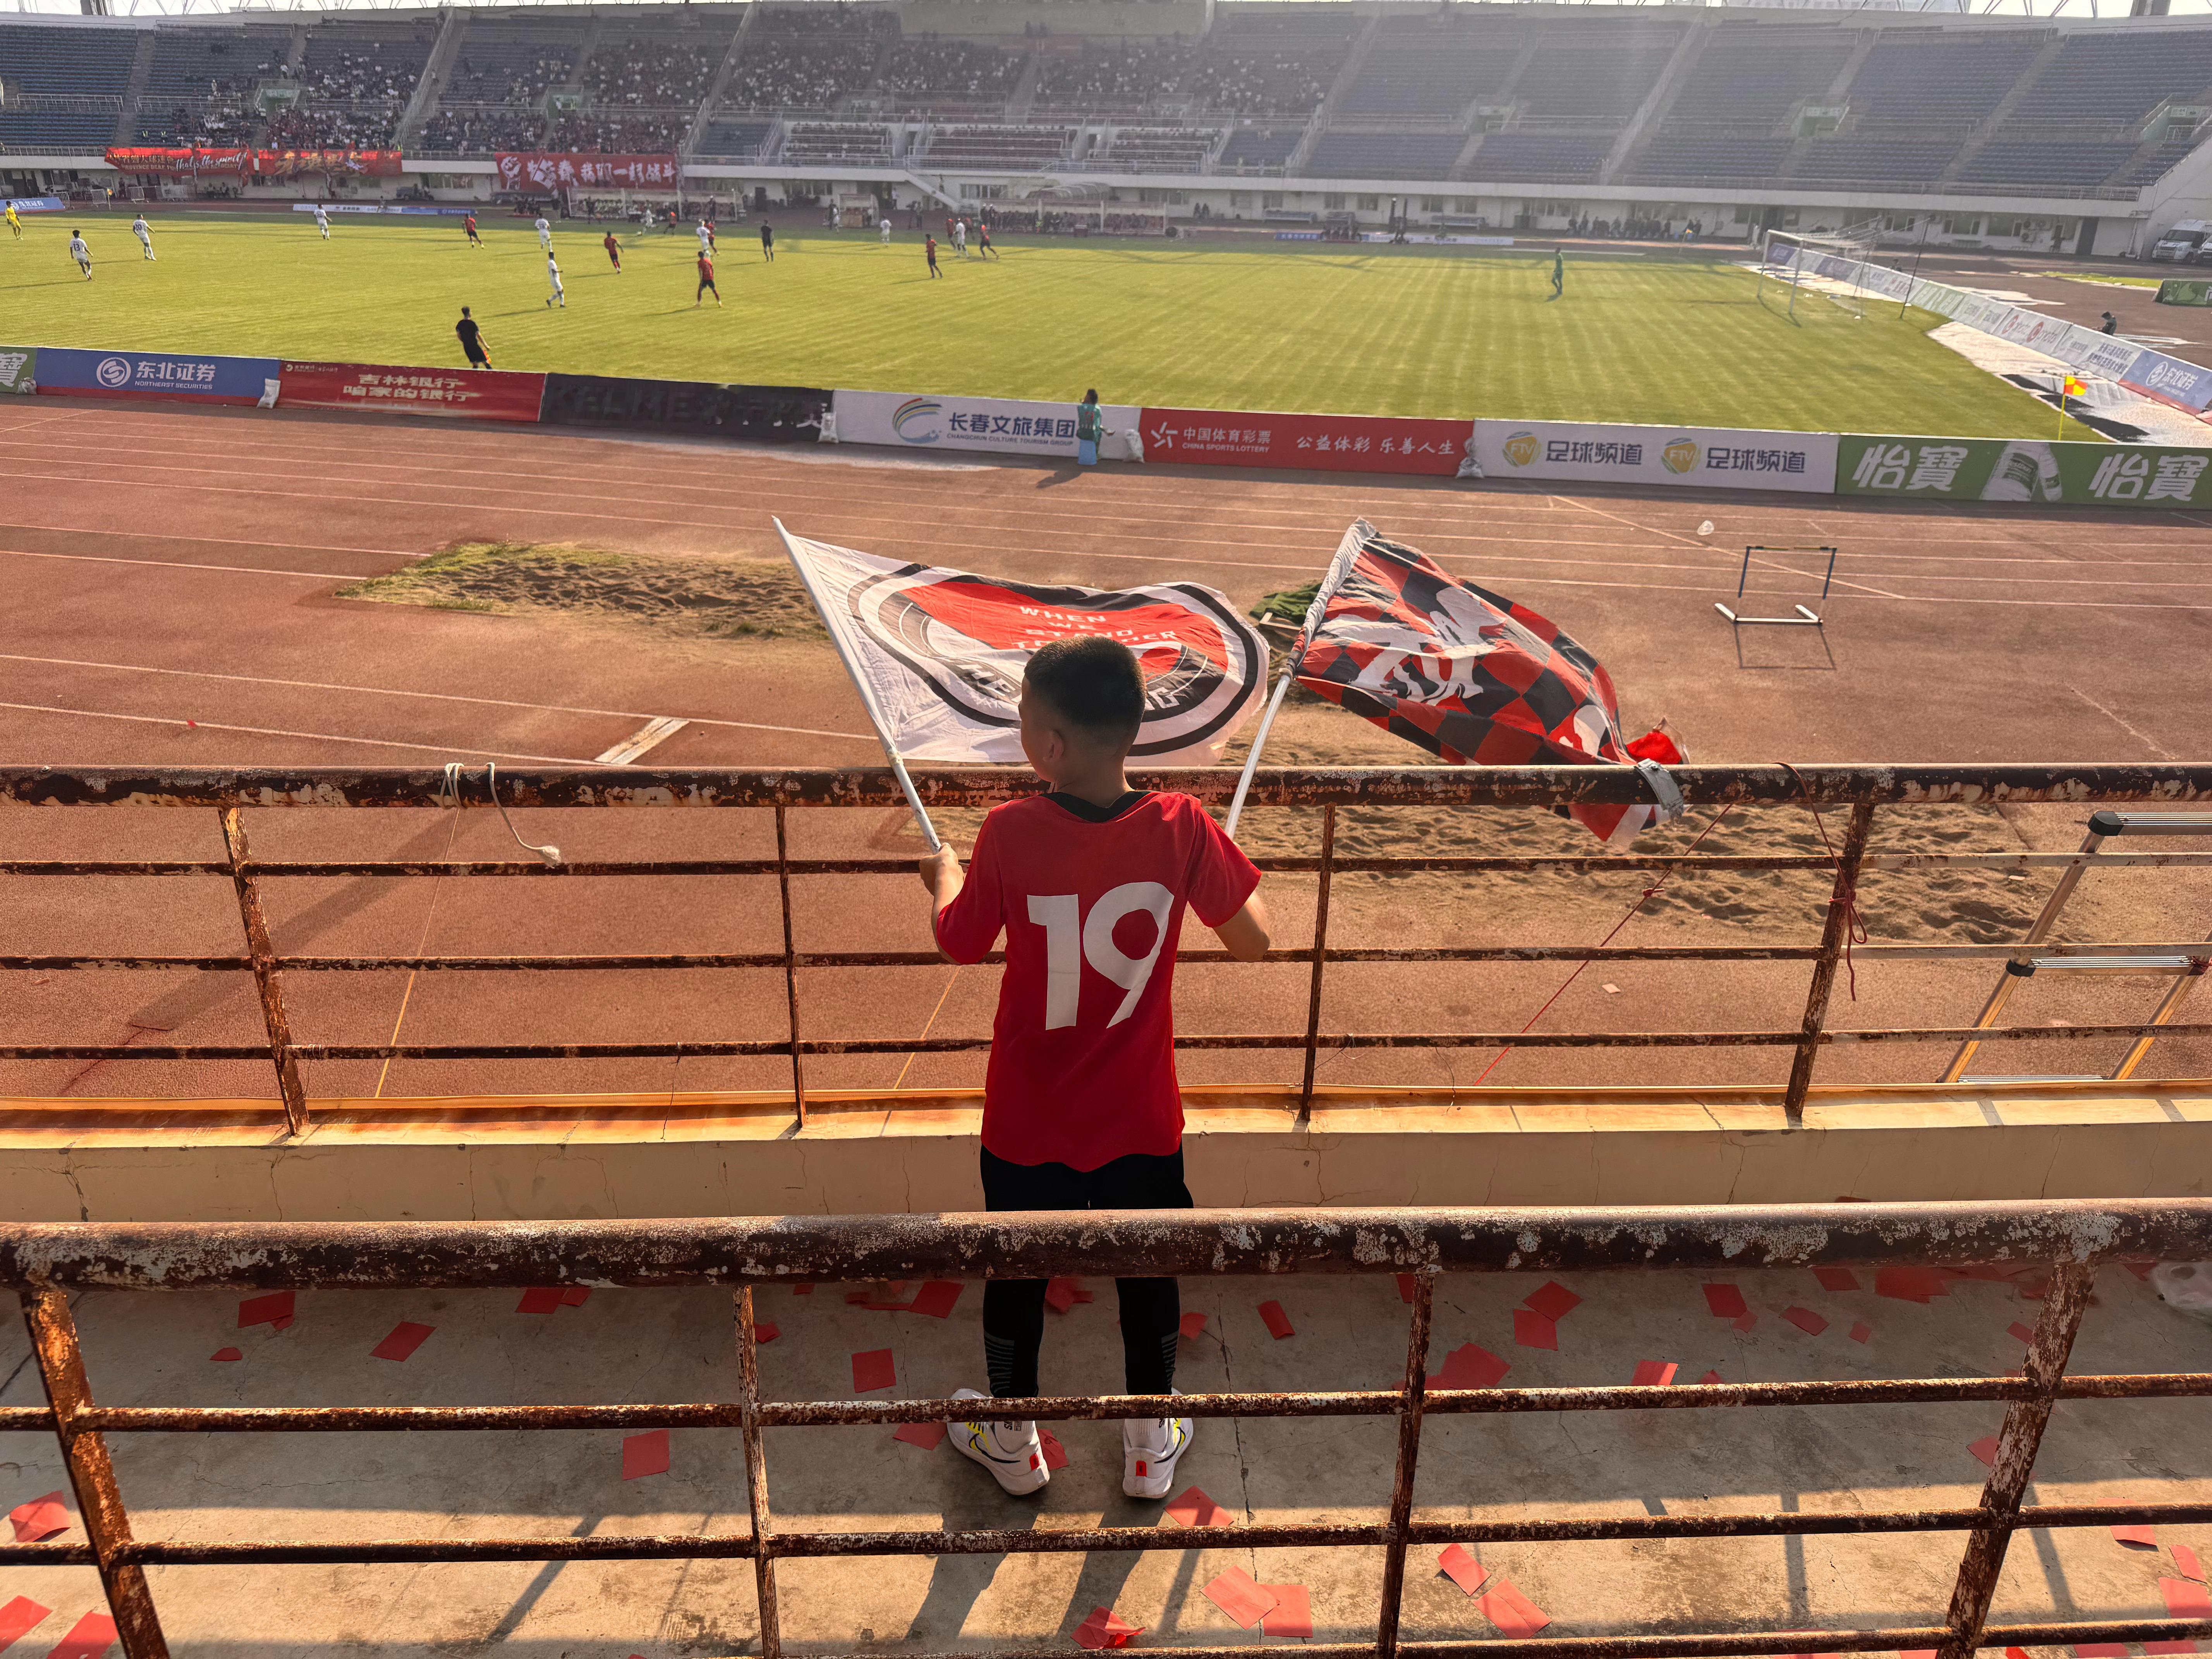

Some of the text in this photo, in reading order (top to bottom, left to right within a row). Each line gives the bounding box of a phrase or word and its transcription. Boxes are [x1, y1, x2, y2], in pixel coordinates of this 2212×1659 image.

[136, 361, 216, 382] 东北证券
[359, 374, 461, 388] 吉林银行
[343, 385, 469, 401] 咱家的银行
[949, 412, 1076, 438] 长春文旅集团
[947, 433, 987, 441] CHANGCHUN
[1183, 426, 1271, 444] 中国体育彩票
[1297, 434, 1455, 454] 公益体彩 乐善人生
[1510, 444, 1534, 455] FTV
[1546, 440, 1643, 465] 足球频道
[1669, 450, 1695, 461] FTV
[1706, 447, 1806, 473] 足球频道
[1852, 444, 1969, 491] 怡寶
[2088, 453, 2209, 501] 怡寶
[1019, 606, 1107, 623] WHEN
[1047, 622, 1096, 630] WE
[1027, 881, 1174, 1030] 19
